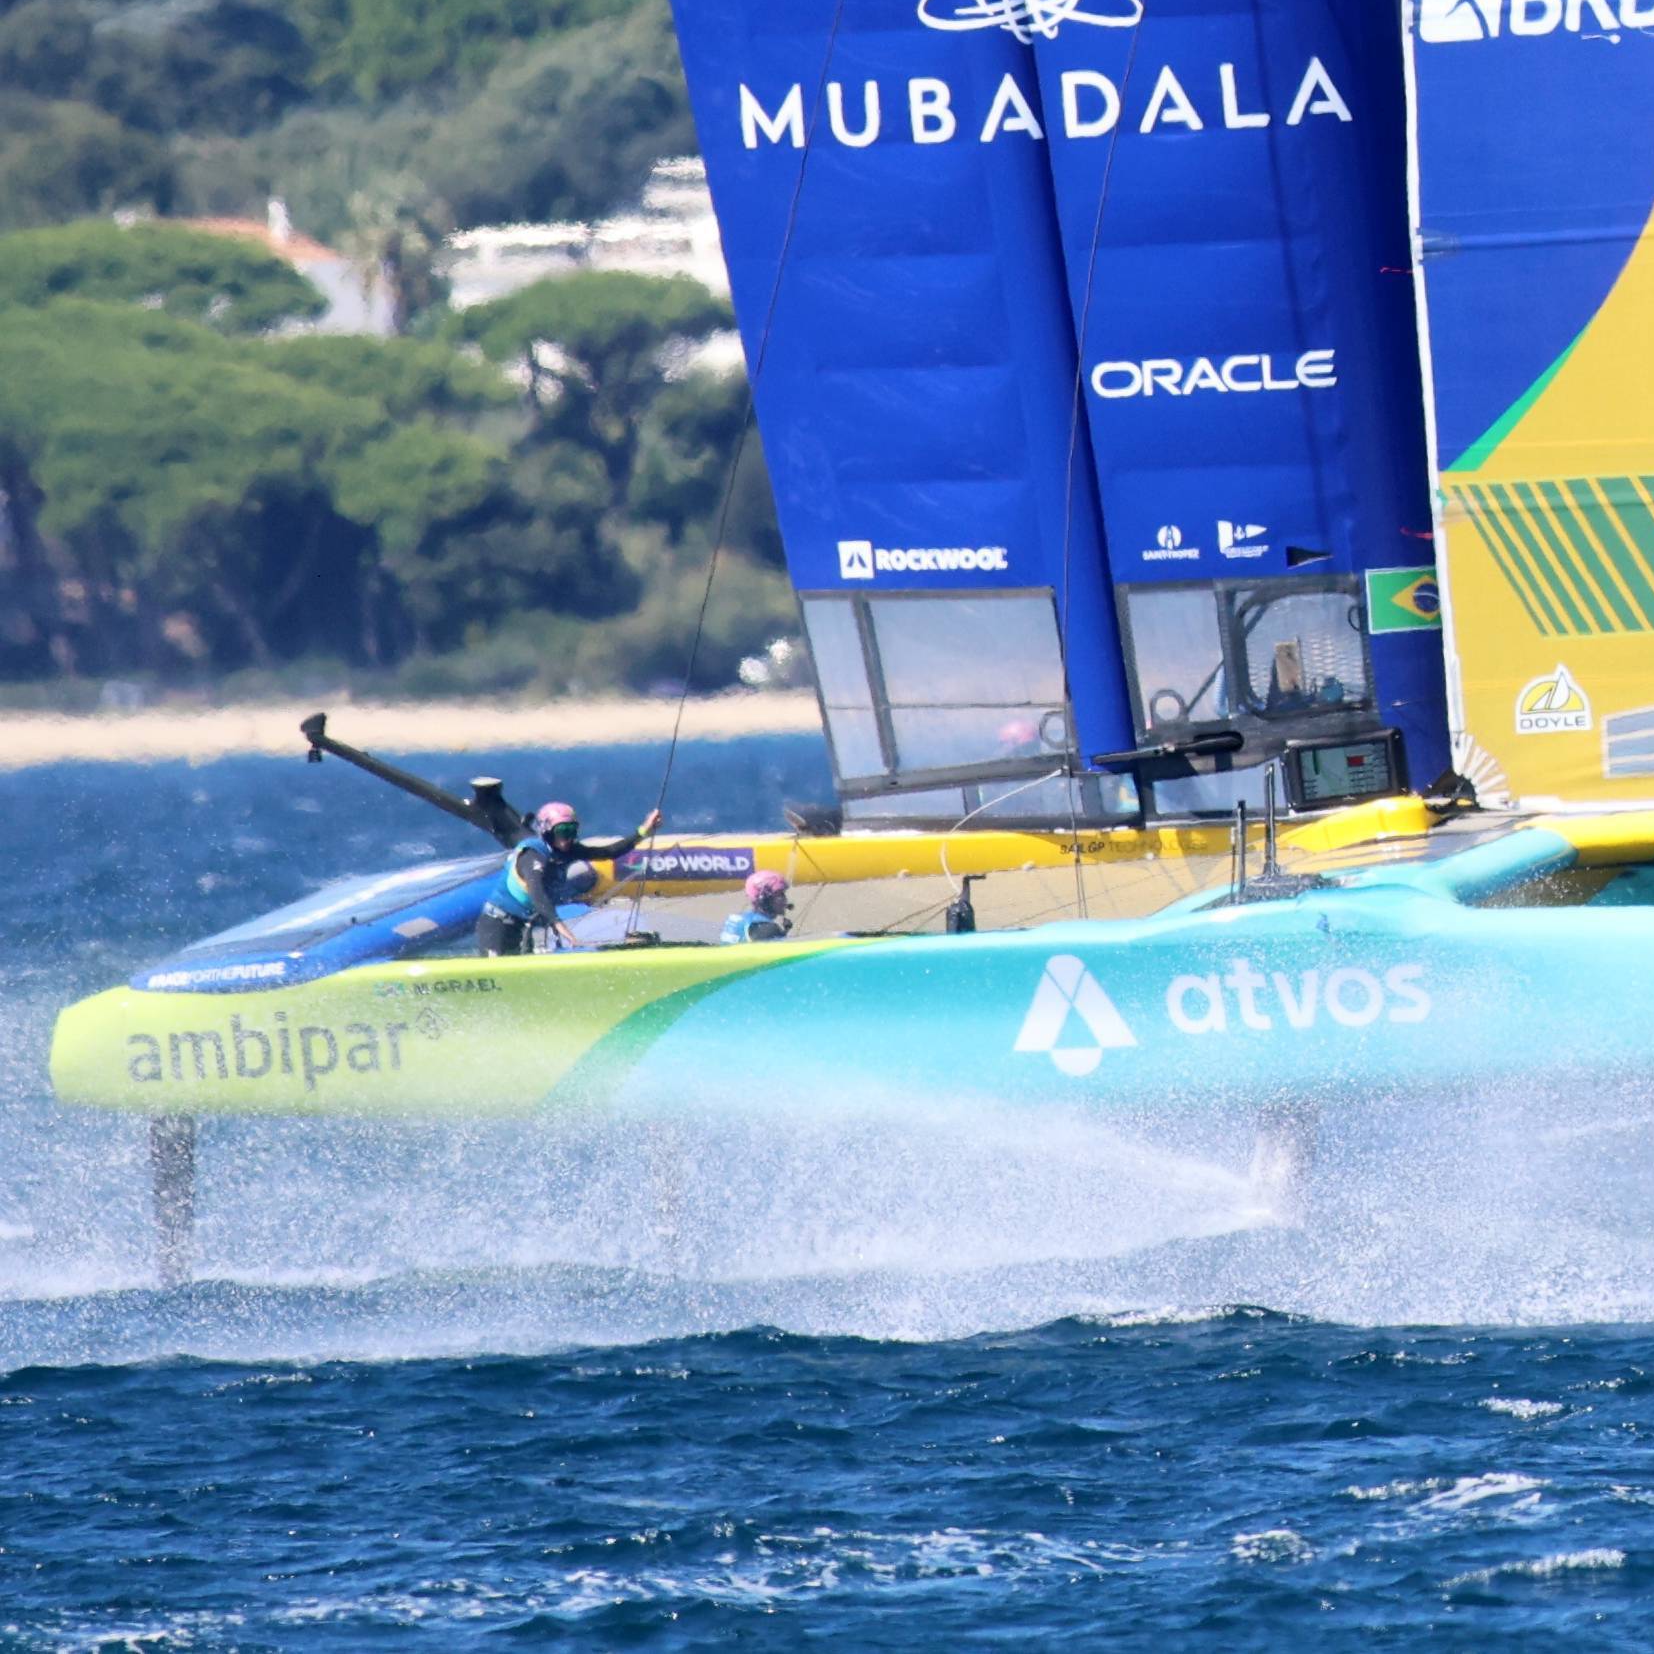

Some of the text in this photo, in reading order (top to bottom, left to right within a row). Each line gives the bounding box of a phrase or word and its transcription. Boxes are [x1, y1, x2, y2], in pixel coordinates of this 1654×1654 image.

[739, 56, 1353, 149] MUBADALA
[1091, 348, 1337, 399] ORACLE
[875, 547, 1009, 572] ROCKWOOL
[1520, 715, 1586, 730] DOYLE
[651, 855, 750, 872] DP WORLD
[1165, 957, 1432, 1035] atvos
[127, 1010, 410, 1093] ambipar
